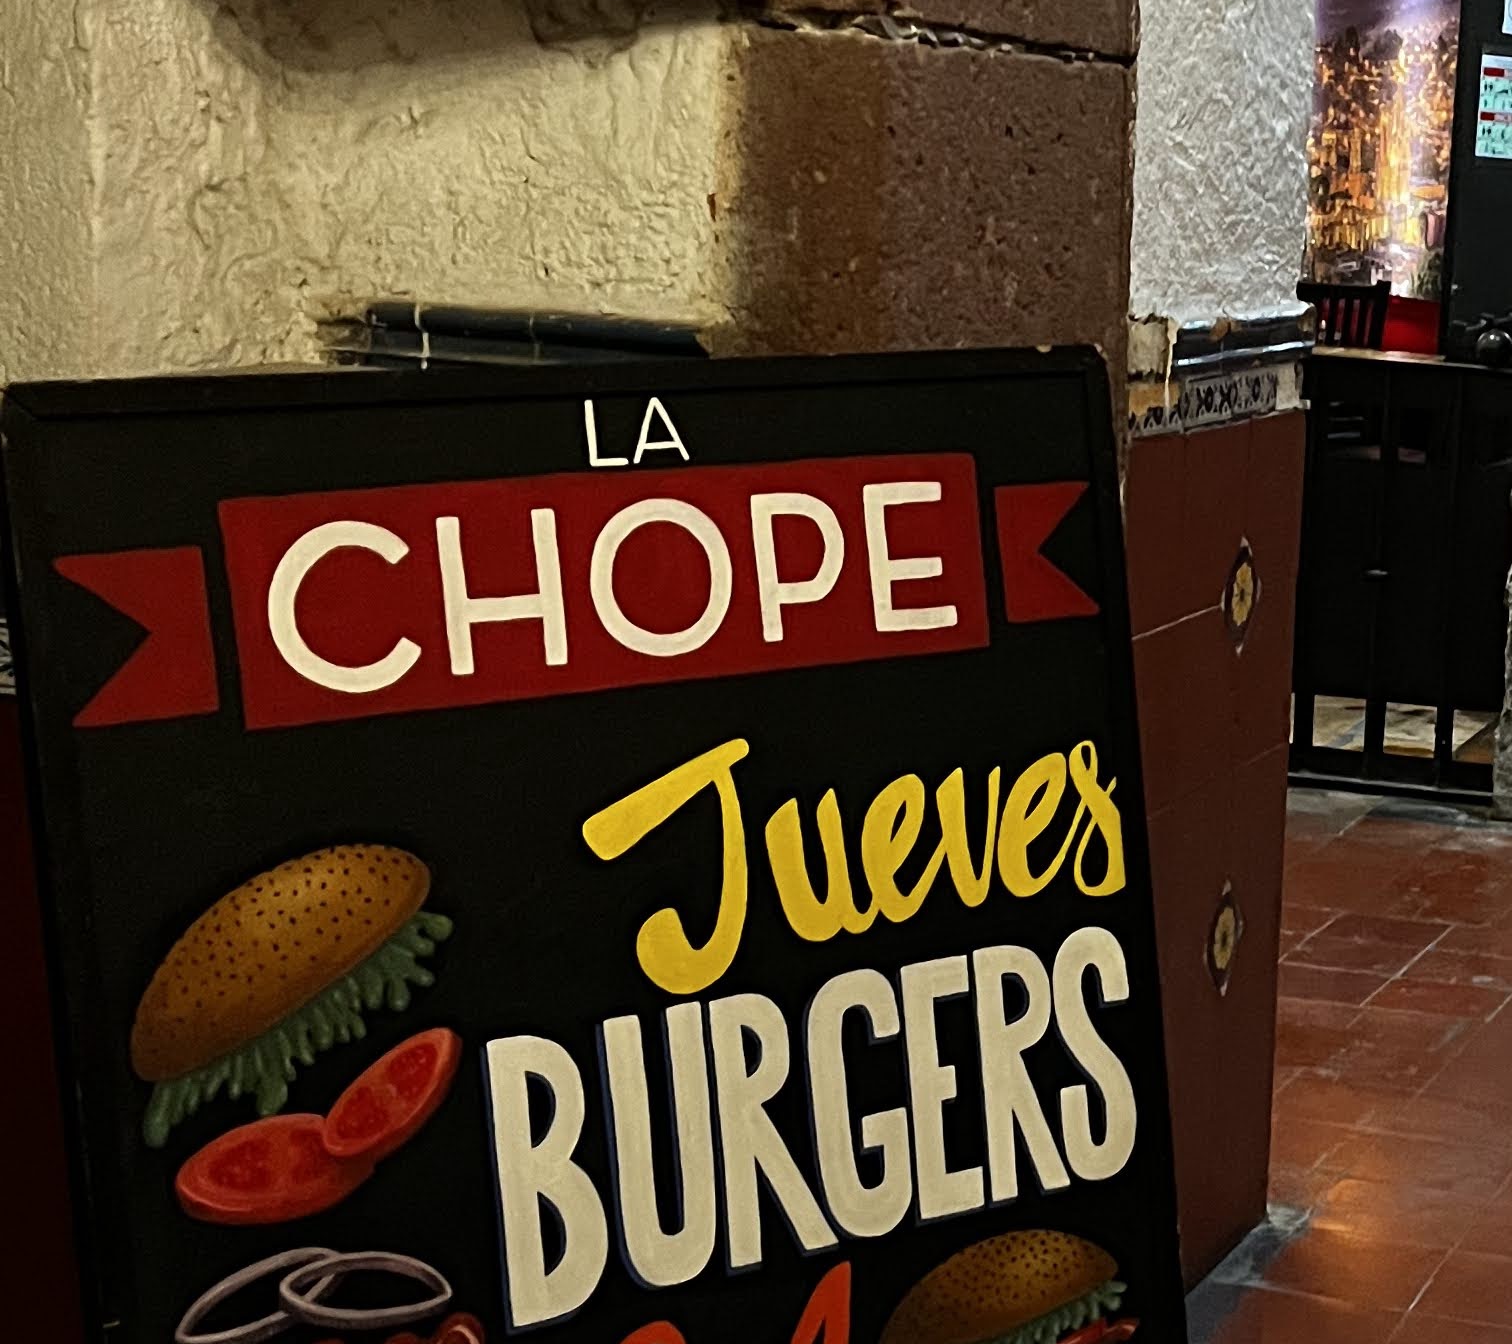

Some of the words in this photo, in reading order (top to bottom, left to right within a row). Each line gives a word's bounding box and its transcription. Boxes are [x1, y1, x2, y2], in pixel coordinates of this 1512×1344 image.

[583, 396, 691, 468] LA
[267, 480, 958, 694] CHOPE
[582, 737, 1127, 995] Jueves
[482, 925, 1138, 1333] BURGERS
